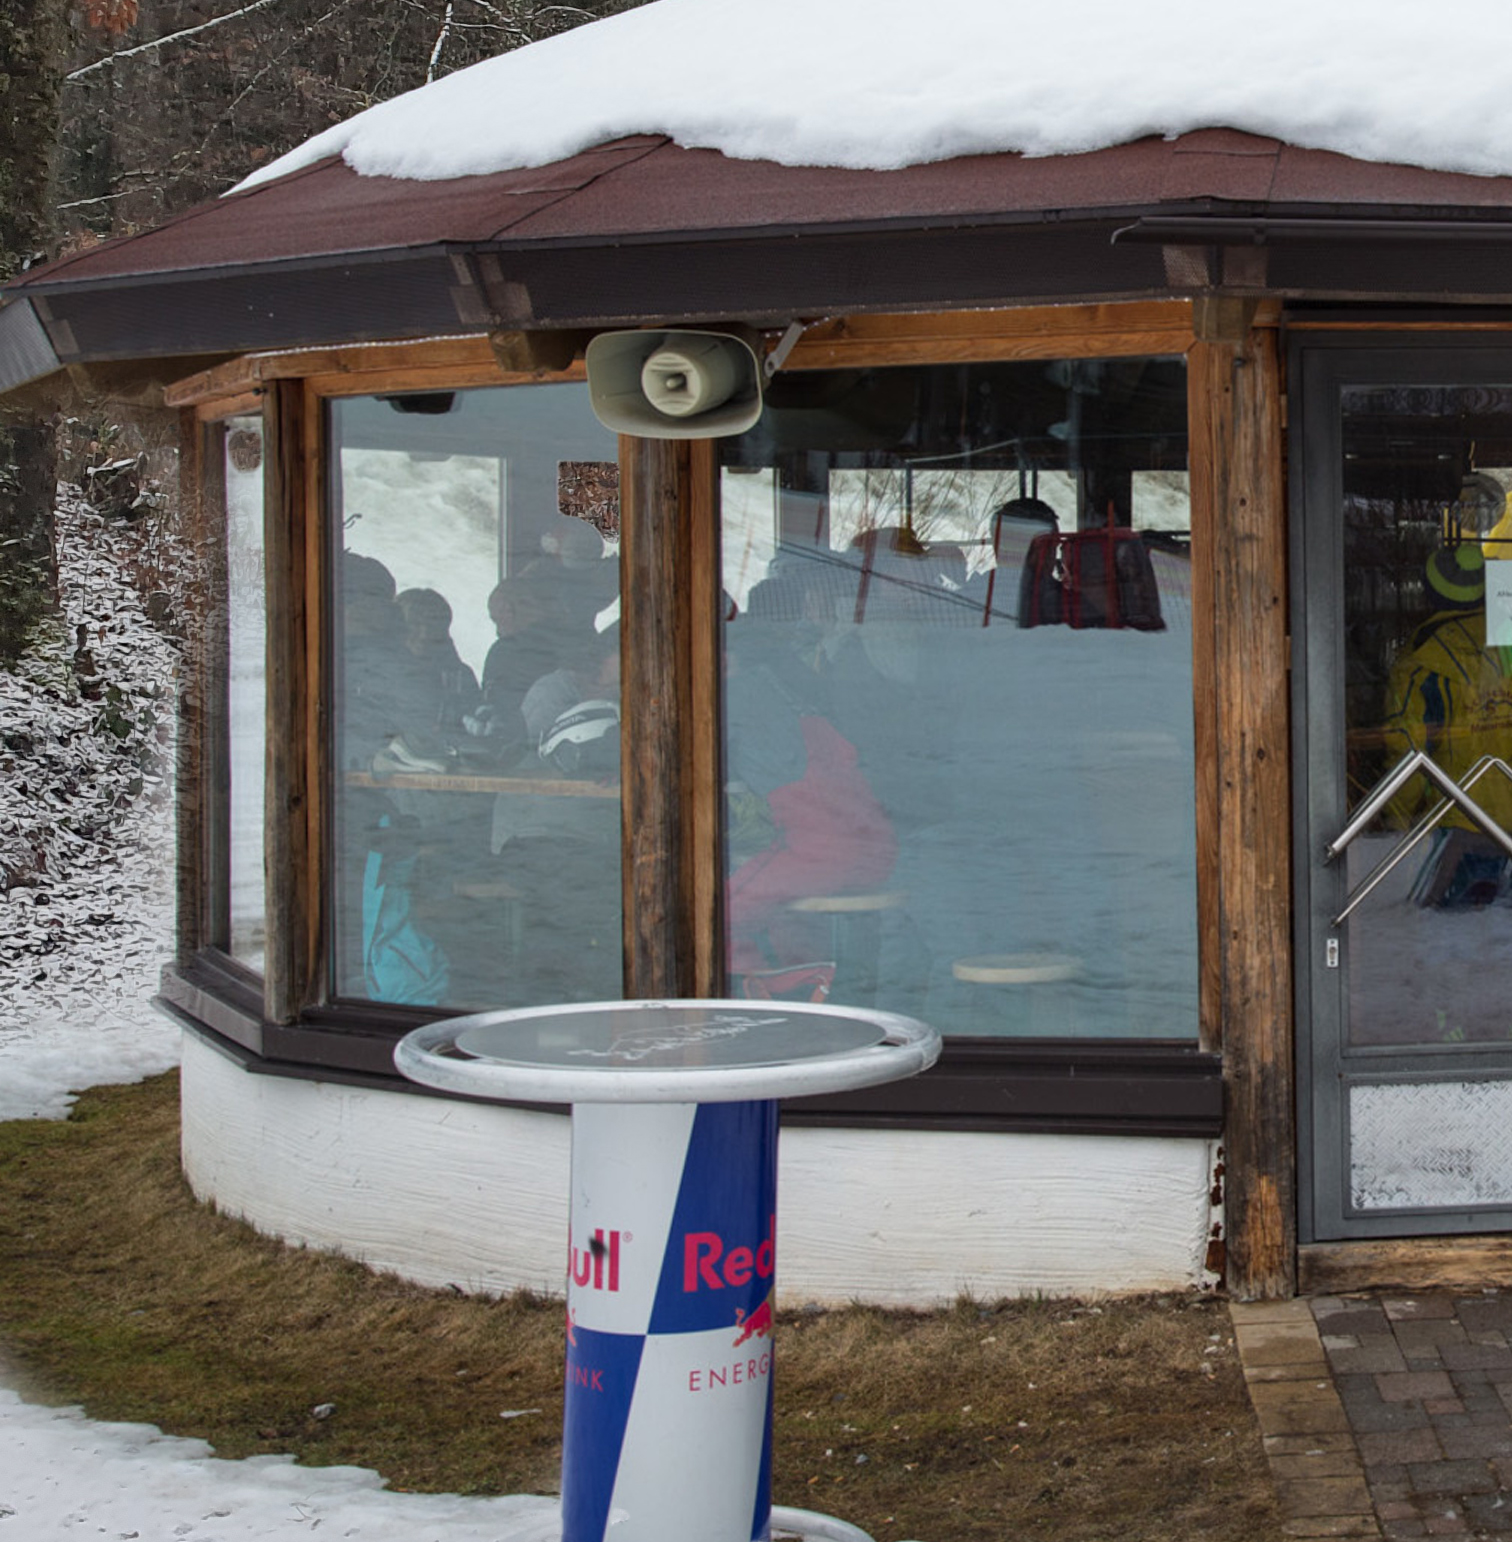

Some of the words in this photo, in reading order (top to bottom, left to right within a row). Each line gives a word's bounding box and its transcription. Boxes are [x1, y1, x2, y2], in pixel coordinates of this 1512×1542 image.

[567, 1228, 620, 1292] ull
[683, 1214, 776, 1293] Red
[566, 1360, 603, 1391] INK
[689, 1352, 772, 1391] ENERG
